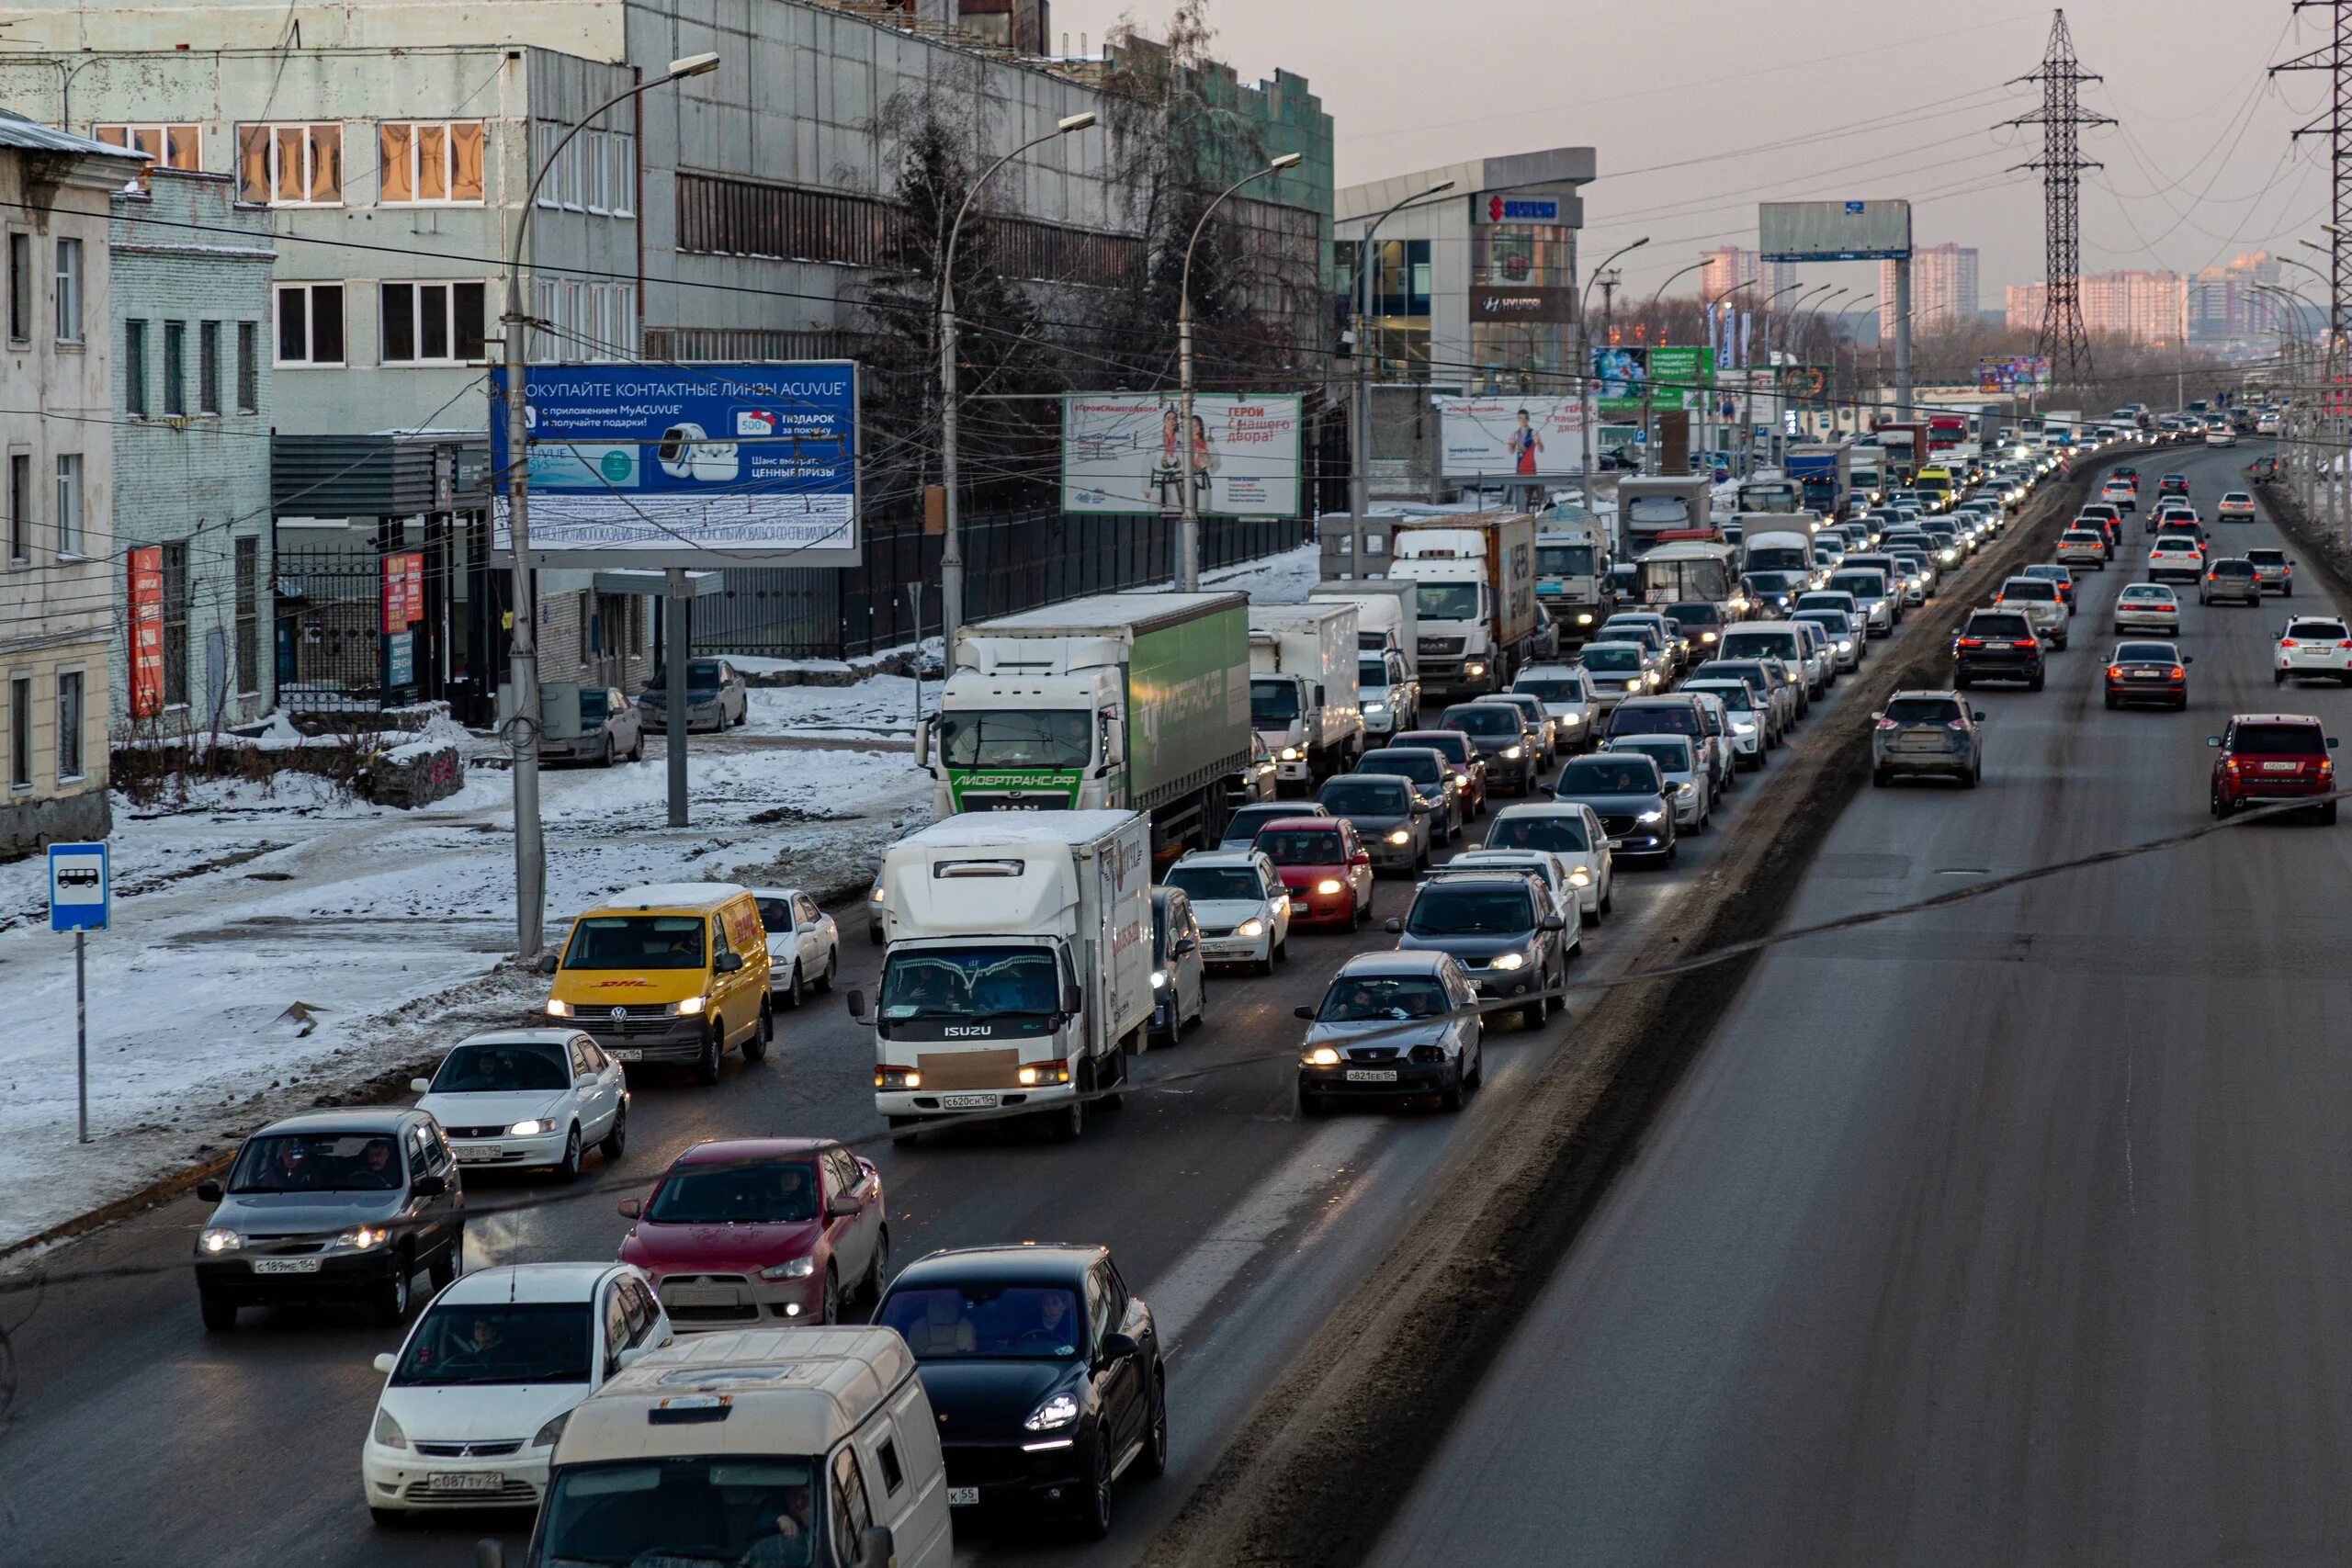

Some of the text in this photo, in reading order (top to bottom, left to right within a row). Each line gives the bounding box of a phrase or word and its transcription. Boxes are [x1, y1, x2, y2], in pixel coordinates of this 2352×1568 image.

[526, 381, 611, 397] ОКУПАЙТЕ
[616, 382, 718, 397] КОНТАКТНЫЕ
[721, 382, 776, 397] ЛИНЗЫ
[549, 407, 617, 416] приложением
[1228, 407, 1264, 418] ГЕРОИ
[542, 417, 647, 429] и получайте подарки!
[782, 414, 835, 424] ПОДАРОК
[1238, 420, 1290, 431] нашего
[1227, 431, 1274, 445] двора!
[752, 456, 777, 465] Шанс
[752, 468, 835, 479] ЦЕННЫЕ ПРИЗЫ
[954, 775, 1077, 786] ЛИДЕРТРАНС.РФ
[944, 1025, 991, 1036] ISUZU
[961, 1488, 975, 1499] 55
